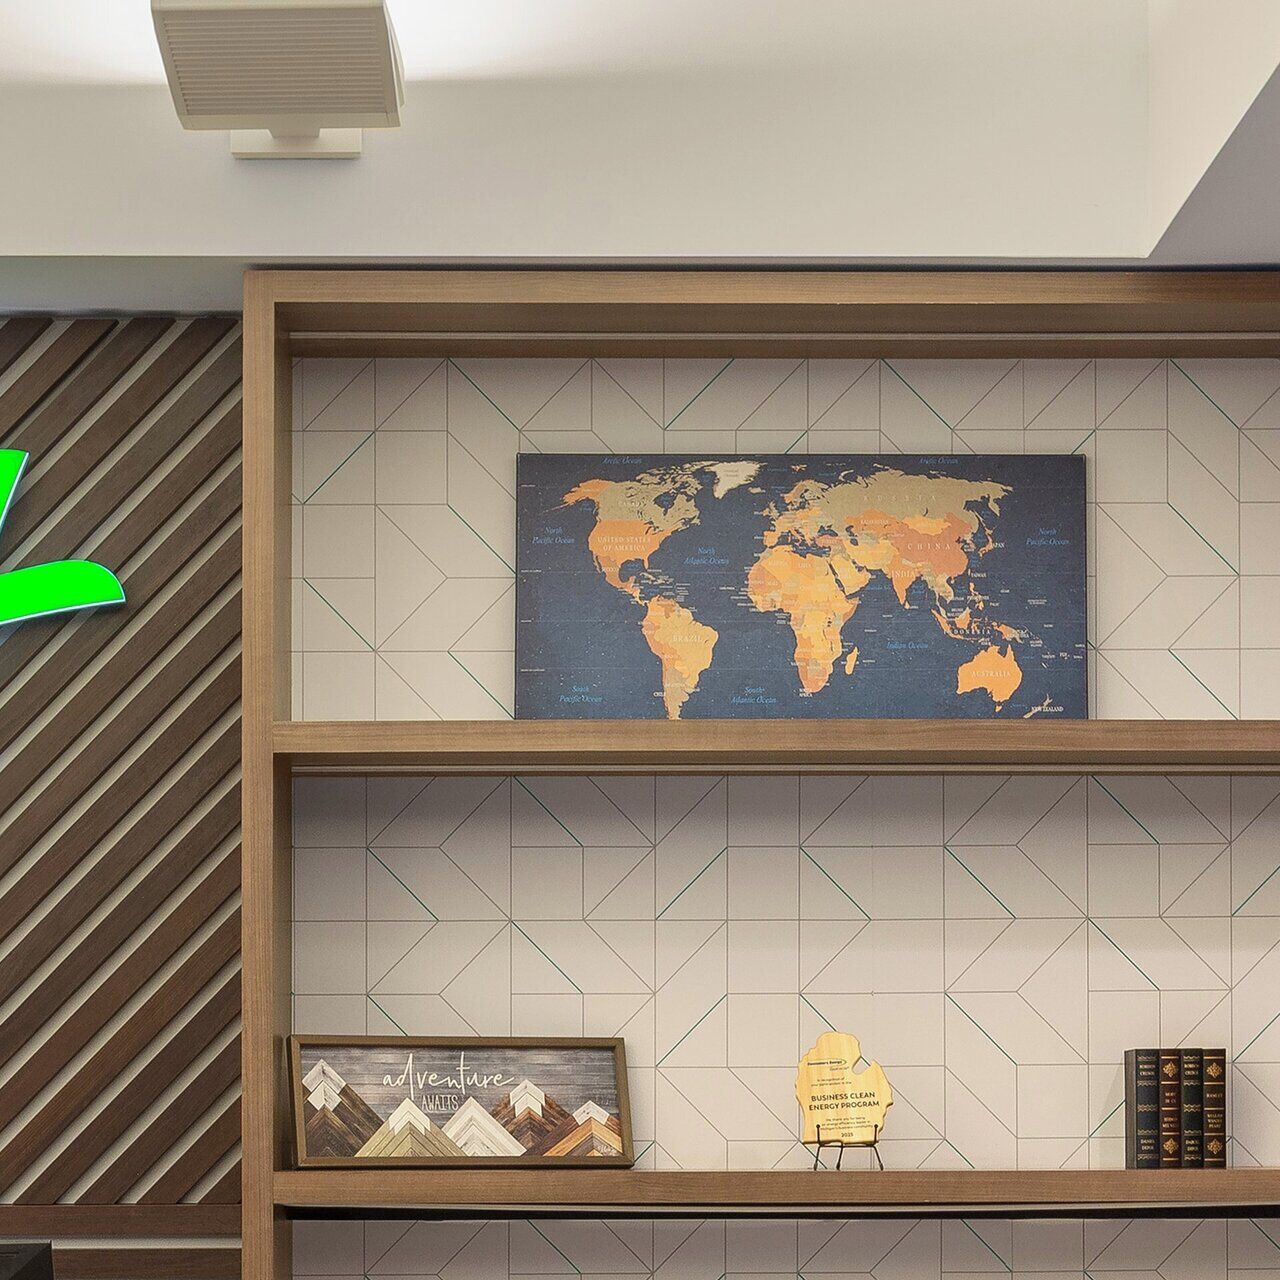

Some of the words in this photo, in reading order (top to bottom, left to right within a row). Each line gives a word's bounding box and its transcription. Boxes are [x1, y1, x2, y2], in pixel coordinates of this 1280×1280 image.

[623, 456, 642, 465] Ocean
[545, 526, 563, 534] North
[1040, 527, 1057, 535] North
[532, 536, 553, 544] Pacific
[554, 536, 575, 544] Ocean
[698, 547, 716, 555] North
[709, 557, 730, 565] Ocean
[887, 641, 907, 649] Indian
[908, 641, 929, 649] Ocean
[382, 1052, 514, 1099] adventure
[811, 1093, 849, 1102] BUSINESS
[850, 1091, 876, 1099] CLEAN
[421, 1094, 459, 1112] AWAITS
[809, 1102, 840, 1111] ENERGY
[841, 1101, 880, 1109] PROGRAM
